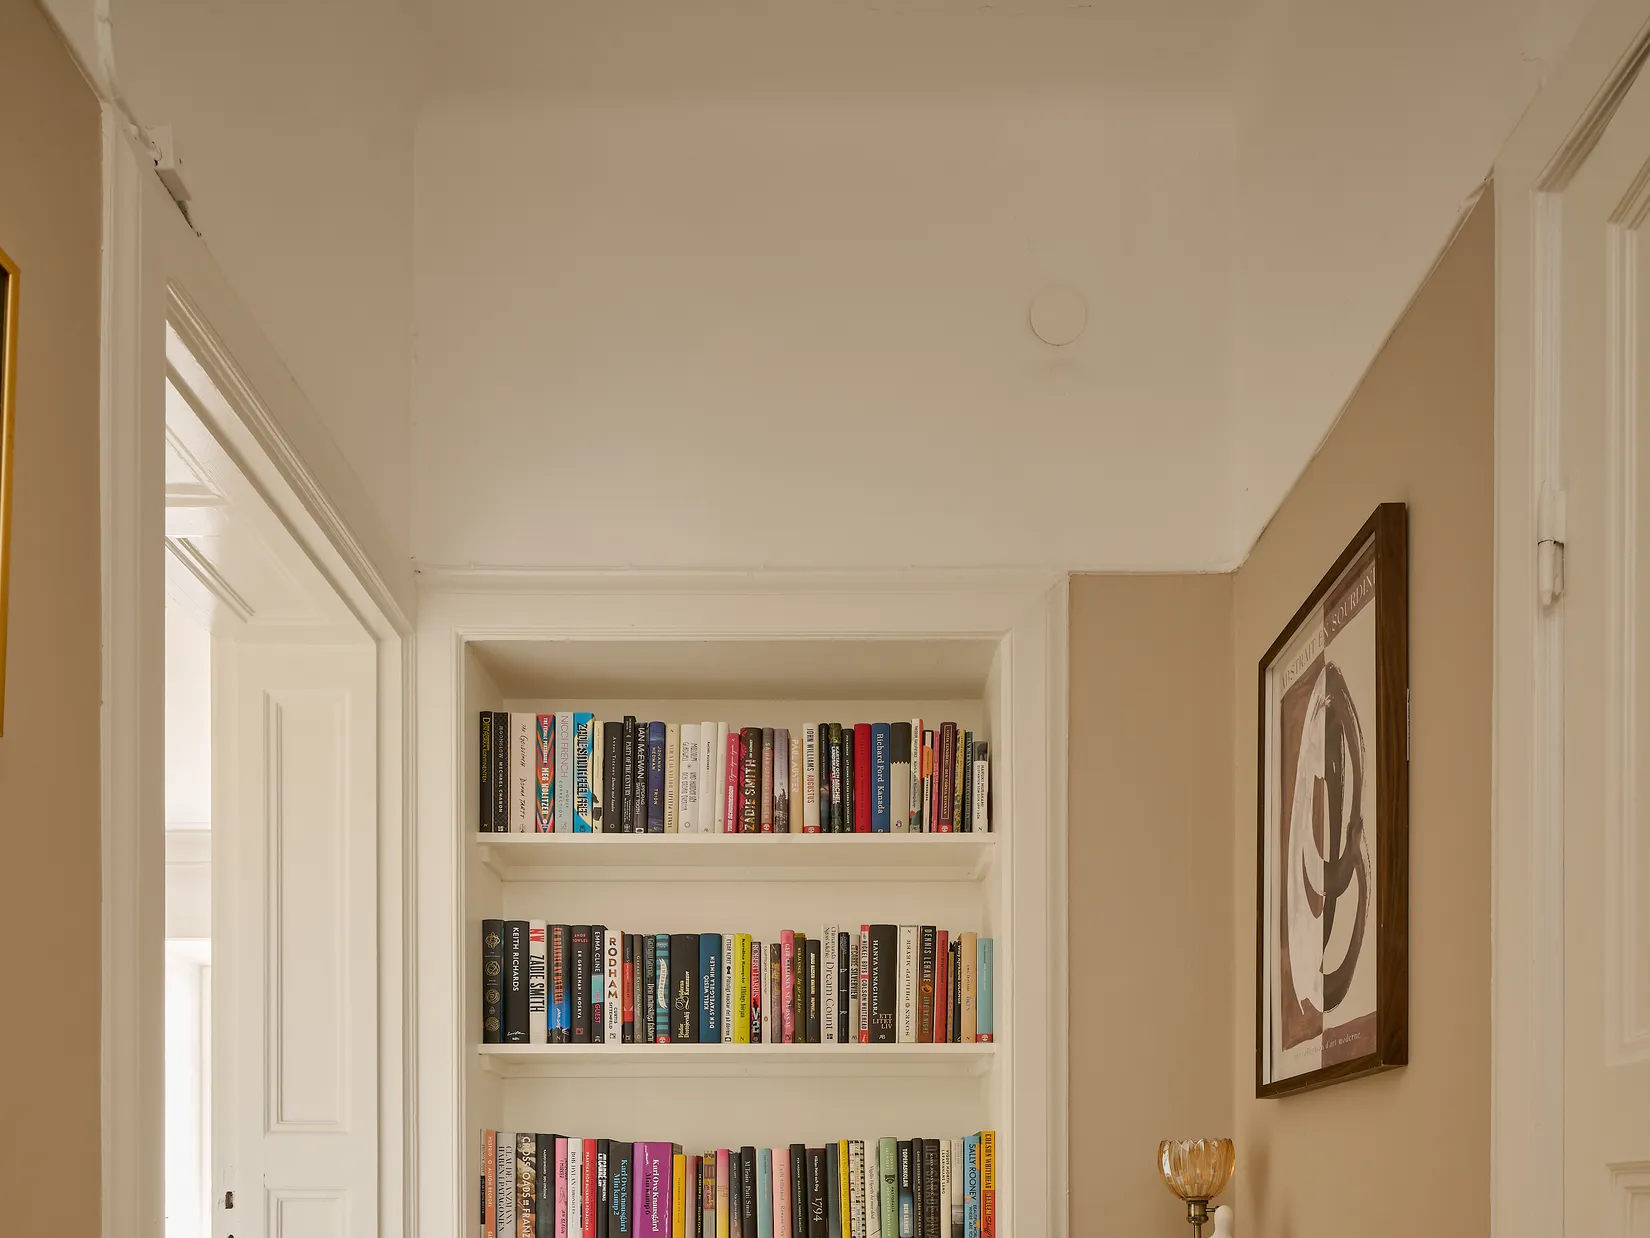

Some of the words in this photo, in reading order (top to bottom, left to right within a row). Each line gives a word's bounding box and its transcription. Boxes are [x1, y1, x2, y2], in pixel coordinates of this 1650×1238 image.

[1318, 627, 1330, 647] EN
[560, 715, 569, 741] NICCI
[577, 723, 589, 747] ZADIE
[560, 743, 569, 778] FRENCH
[791, 739, 799, 761] PAUL
[876, 733, 885, 764] Richard
[577, 748, 589, 776] SMITH
[876, 765, 885, 783] Ford
[577, 776, 589, 797] FEEL
[791, 761, 799, 793] AUSTER
[577, 797, 589, 817] FREE
[877, 785, 885, 814] Kanada
[512, 927, 520, 950] KEITH
[530, 928, 545, 943] NW
[923, 928, 932, 954] DENNIS
[512, 952, 520, 992] RICHARDS
[530, 955, 545, 980] ZADIE
[608, 937, 618, 999] RODHAM
[826, 961, 835, 996] Dream
[923, 956, 932, 983] LEHANE
[530, 982, 545, 1013] SMITH
[826, 998, 835, 1030] Count
[522, 1136, 531, 1198] CROSSROADS
[744, 1160, 751, 1168] M
[612, 1189, 620, 1210] kamp
[619, 1192, 628, 1233] Knausgård
[651, 1191, 659, 1232] Knausgård
[812, 1197, 823, 1222] 1794
